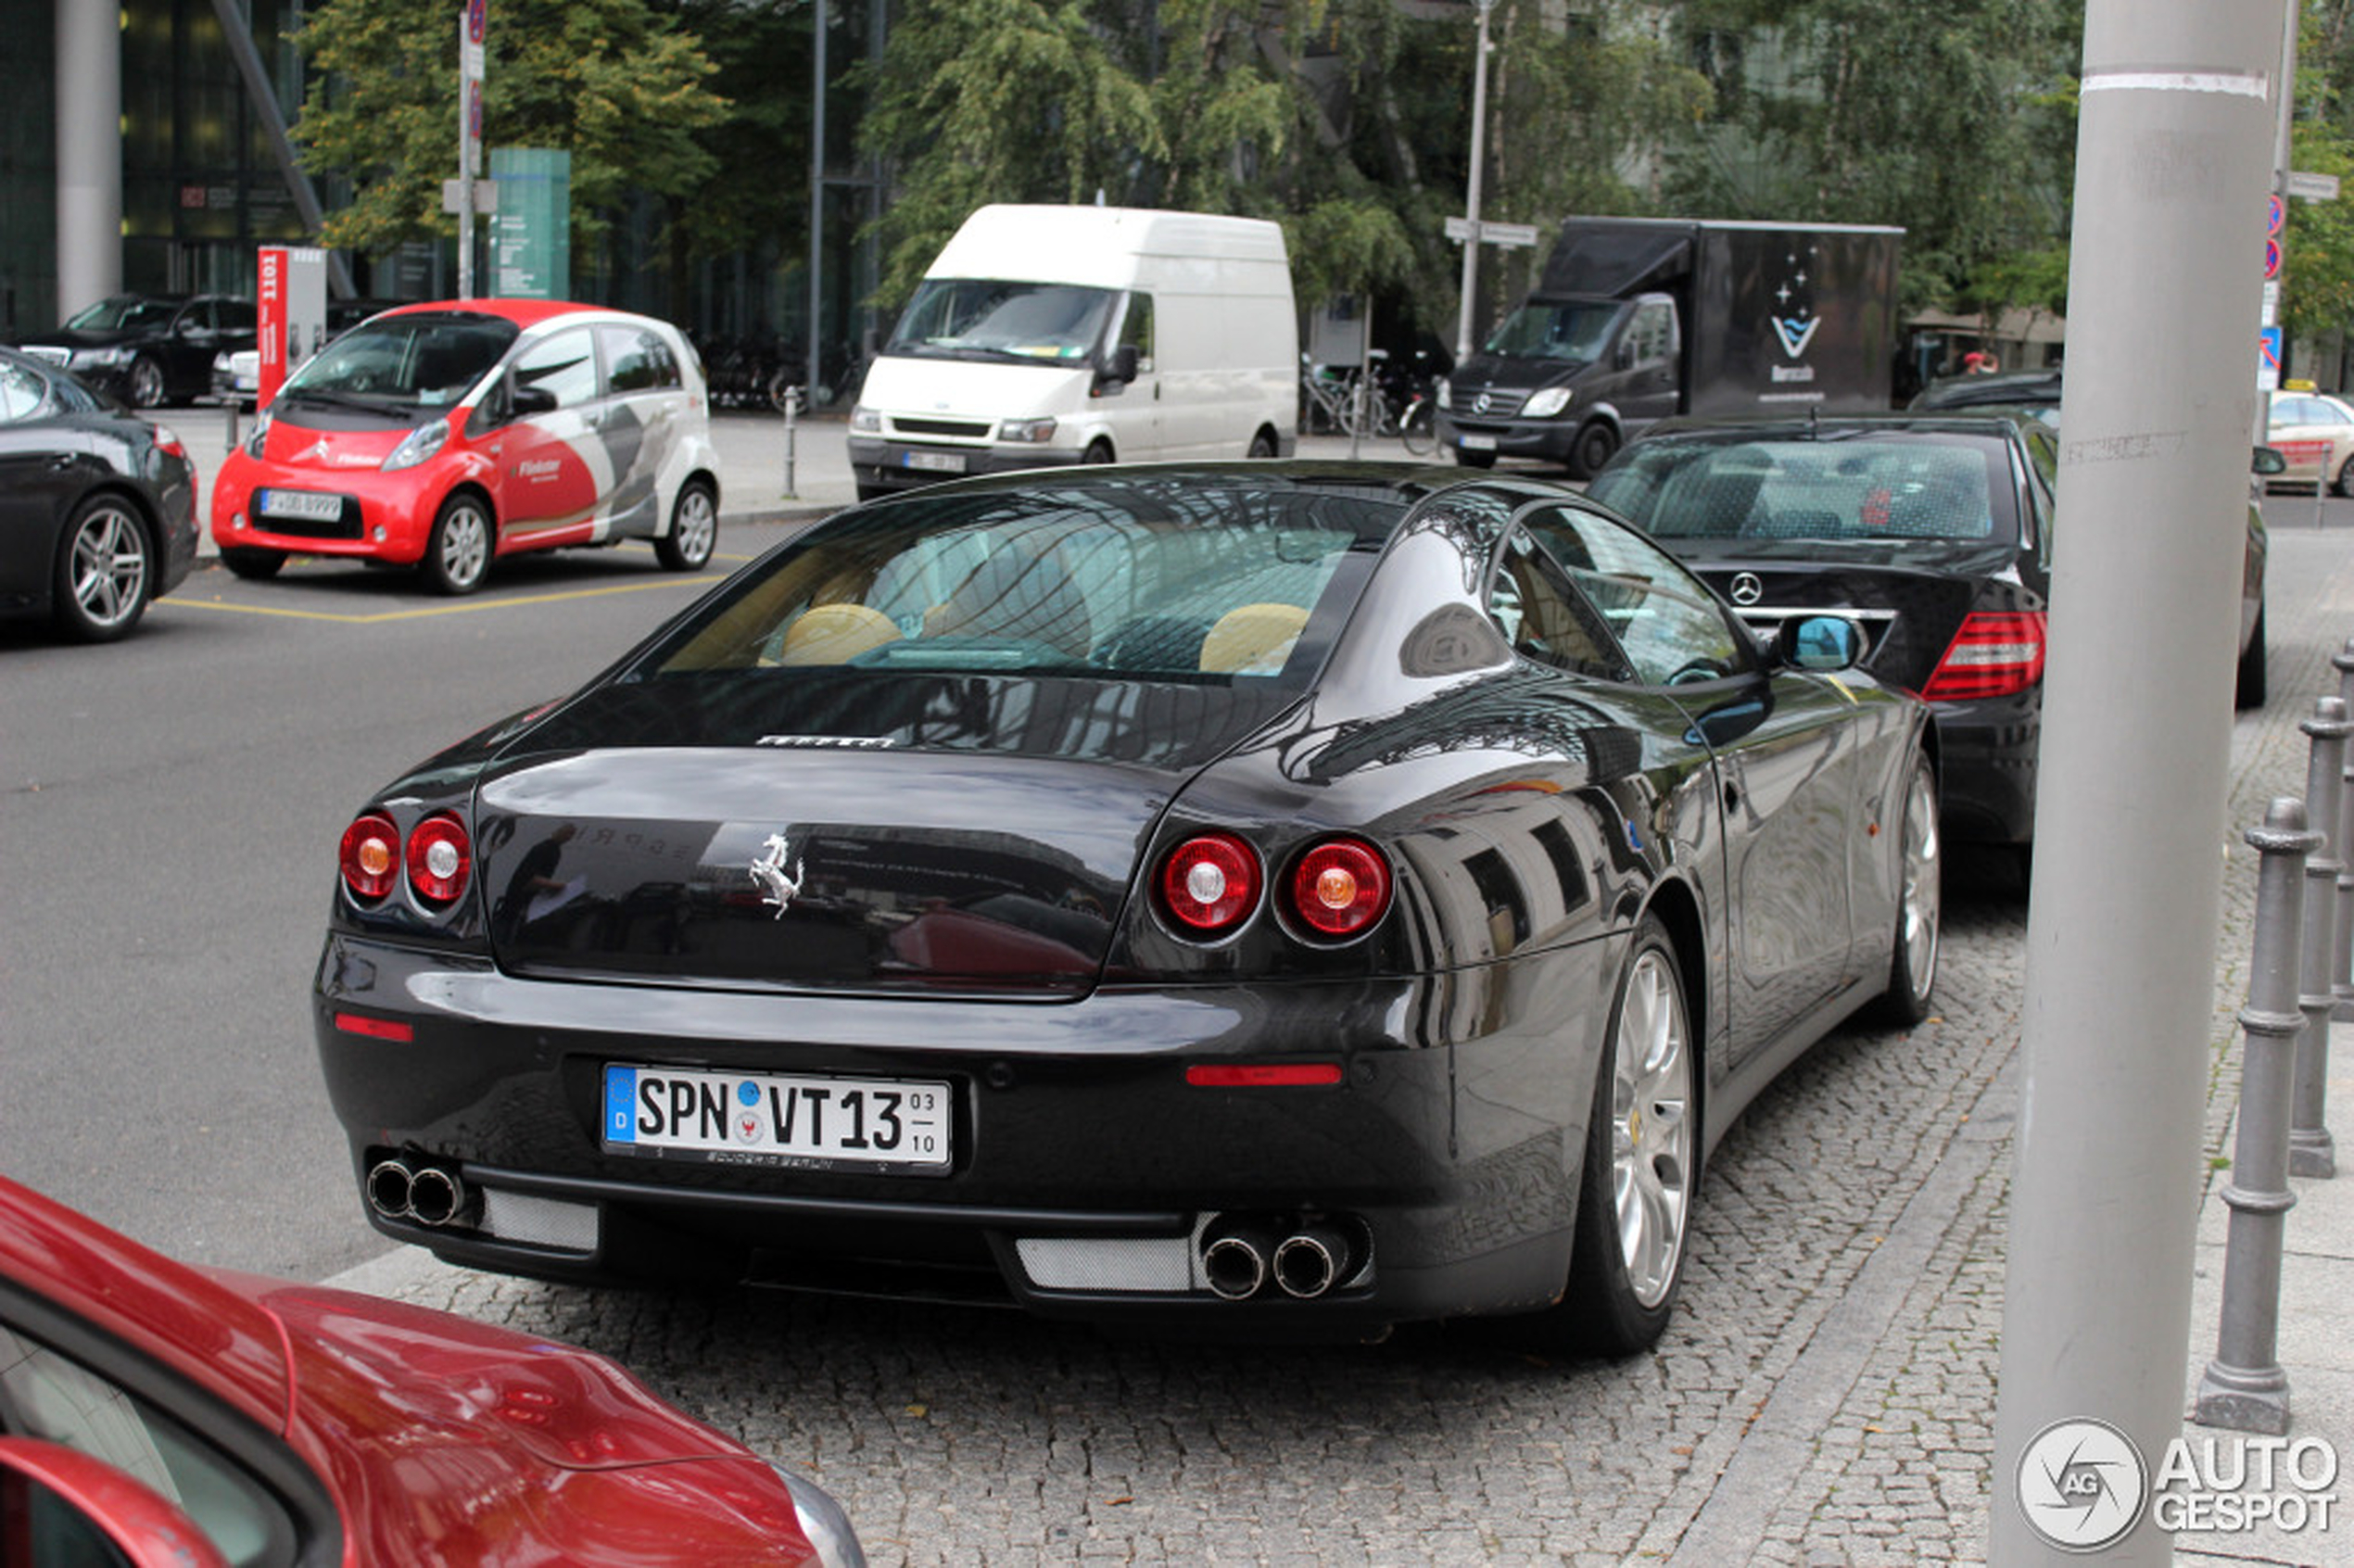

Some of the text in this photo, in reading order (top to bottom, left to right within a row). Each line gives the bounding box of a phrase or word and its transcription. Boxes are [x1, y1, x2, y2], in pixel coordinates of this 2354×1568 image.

[262, 254, 277, 301] 1101
[638, 1078, 728, 1141] SPN
[910, 1093, 935, 1111] 03
[615, 1111, 626, 1130] D
[912, 1134, 936, 1154] 10
